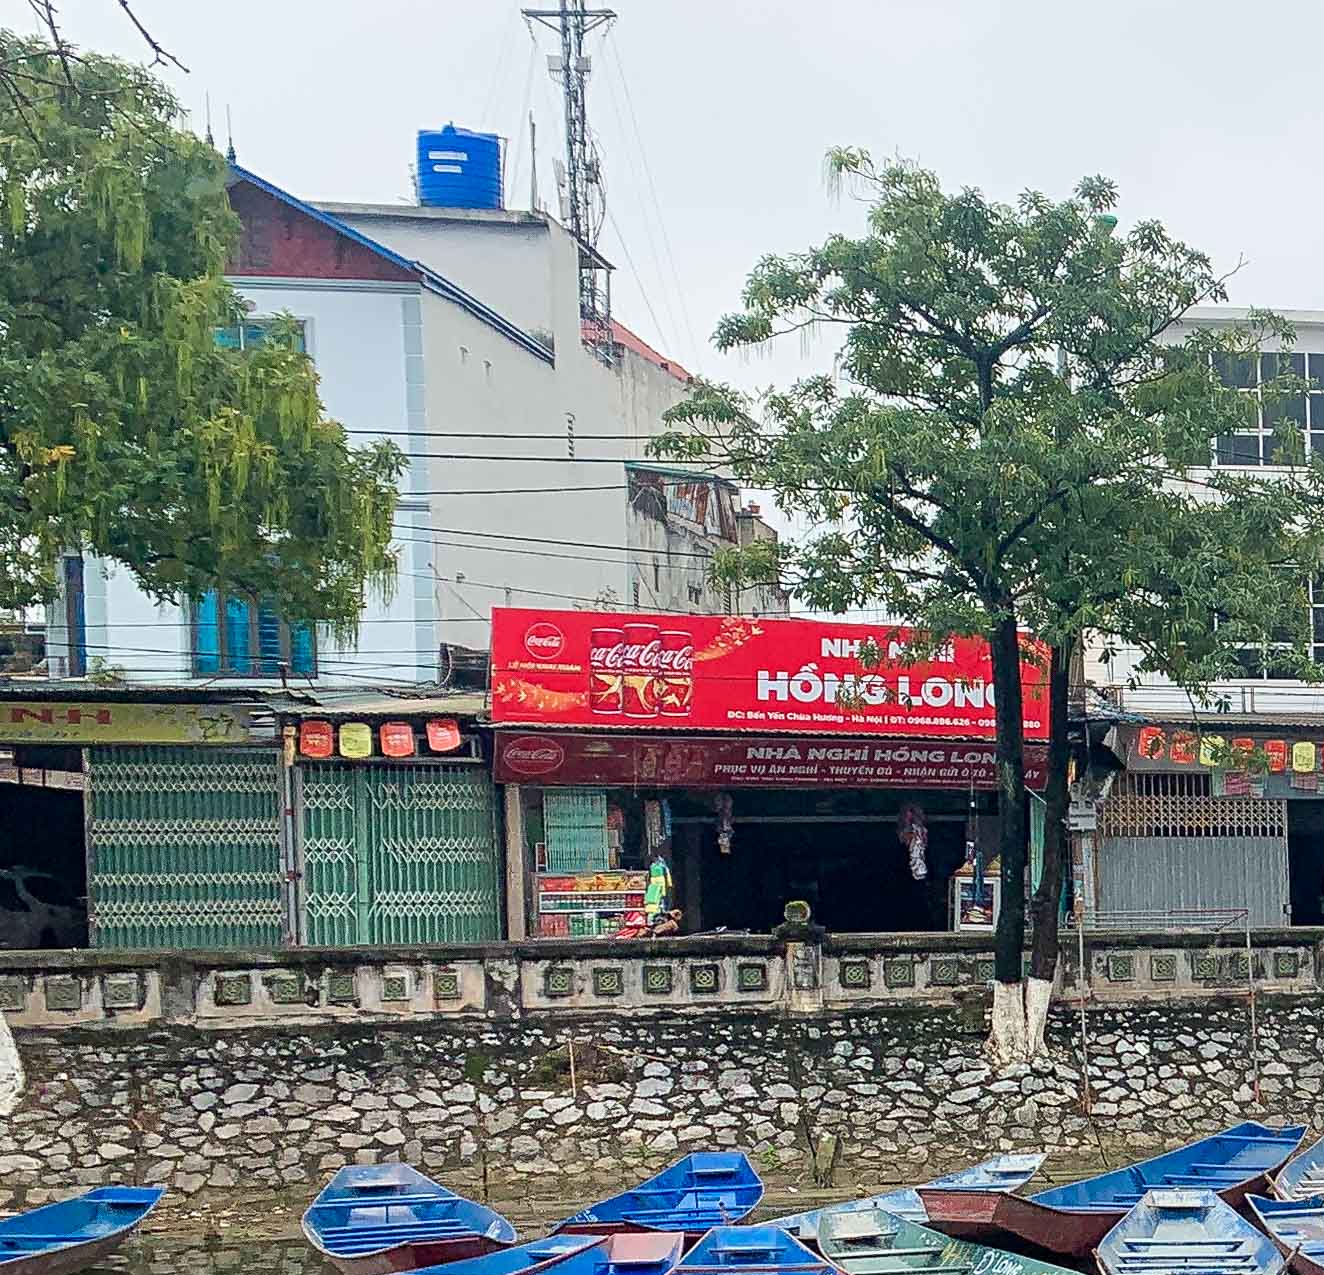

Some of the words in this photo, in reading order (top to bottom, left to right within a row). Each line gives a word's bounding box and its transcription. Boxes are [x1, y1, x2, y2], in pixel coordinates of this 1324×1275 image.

[757, 663, 887, 706] HỒNG
[852, 715, 865, 723] Hà
[866, 715, 883, 724] Nội
[747, 745, 801, 760] NHÀ
[874, 747, 945, 763] HỒNG
[714, 764, 747, 775] PHỤC
